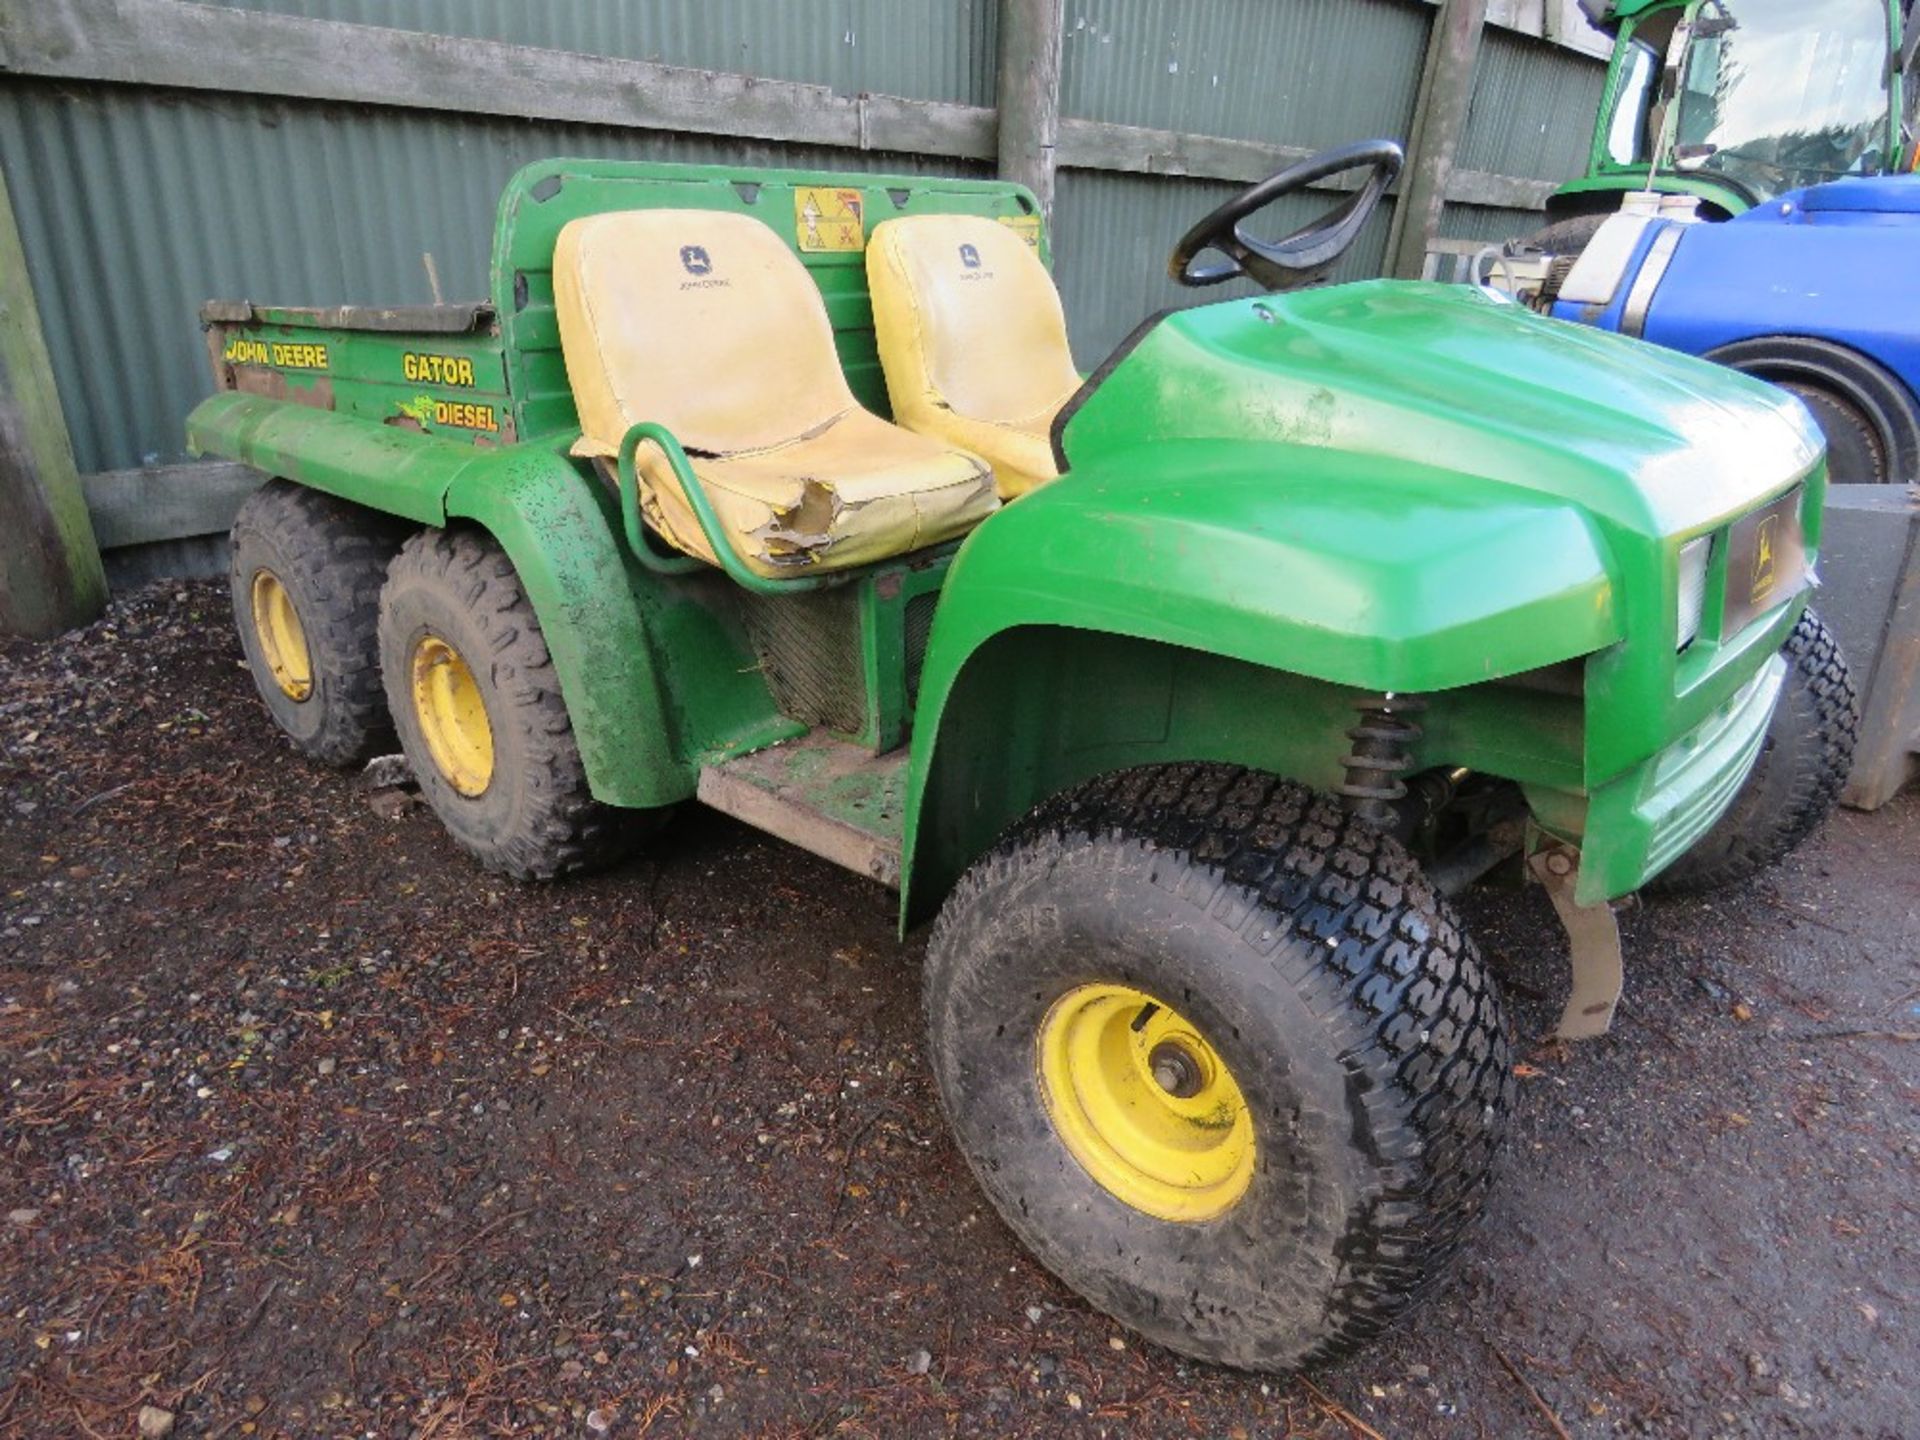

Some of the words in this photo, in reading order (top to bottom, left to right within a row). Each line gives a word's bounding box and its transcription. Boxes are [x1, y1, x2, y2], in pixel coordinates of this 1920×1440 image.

[225, 340, 269, 364] JOHN
[271, 343, 328, 368] DEERE
[403, 352, 475, 387] GATOR
[435, 401, 499, 432] DIESEL
